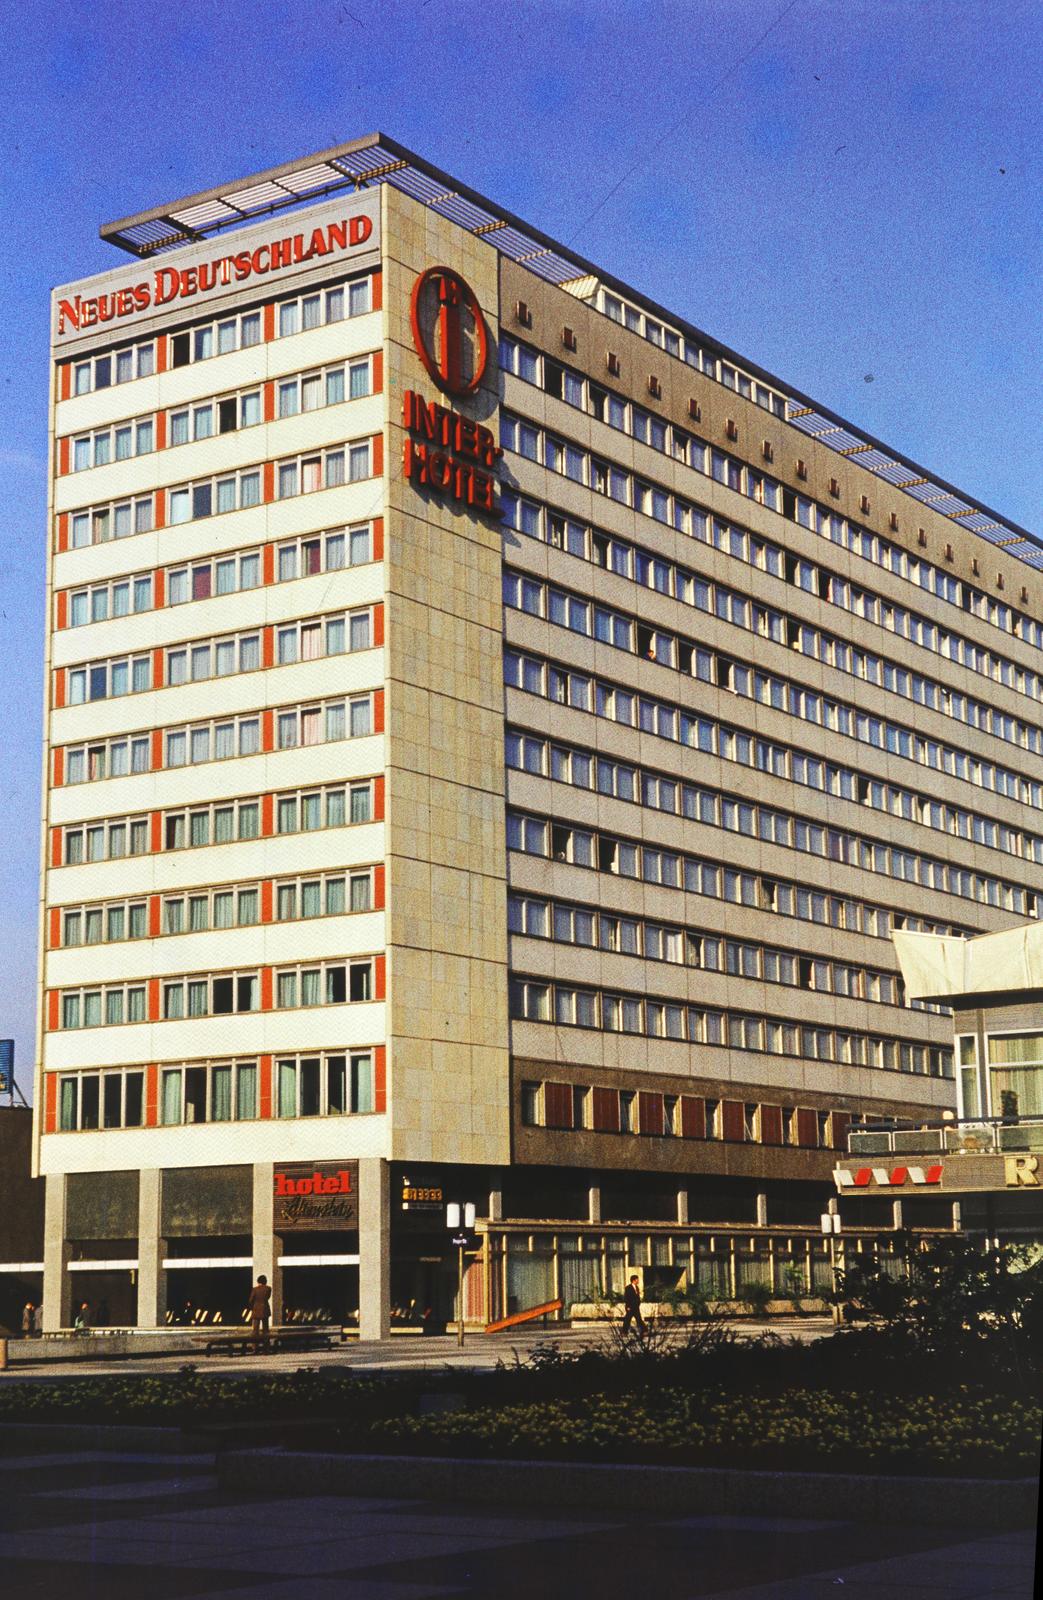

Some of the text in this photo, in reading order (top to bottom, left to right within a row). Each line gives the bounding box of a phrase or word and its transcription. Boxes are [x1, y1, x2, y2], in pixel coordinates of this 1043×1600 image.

[57, 214, 374, 335] NEUES DEUTSCHLAND
[273, 1170, 352, 1196] hotel
